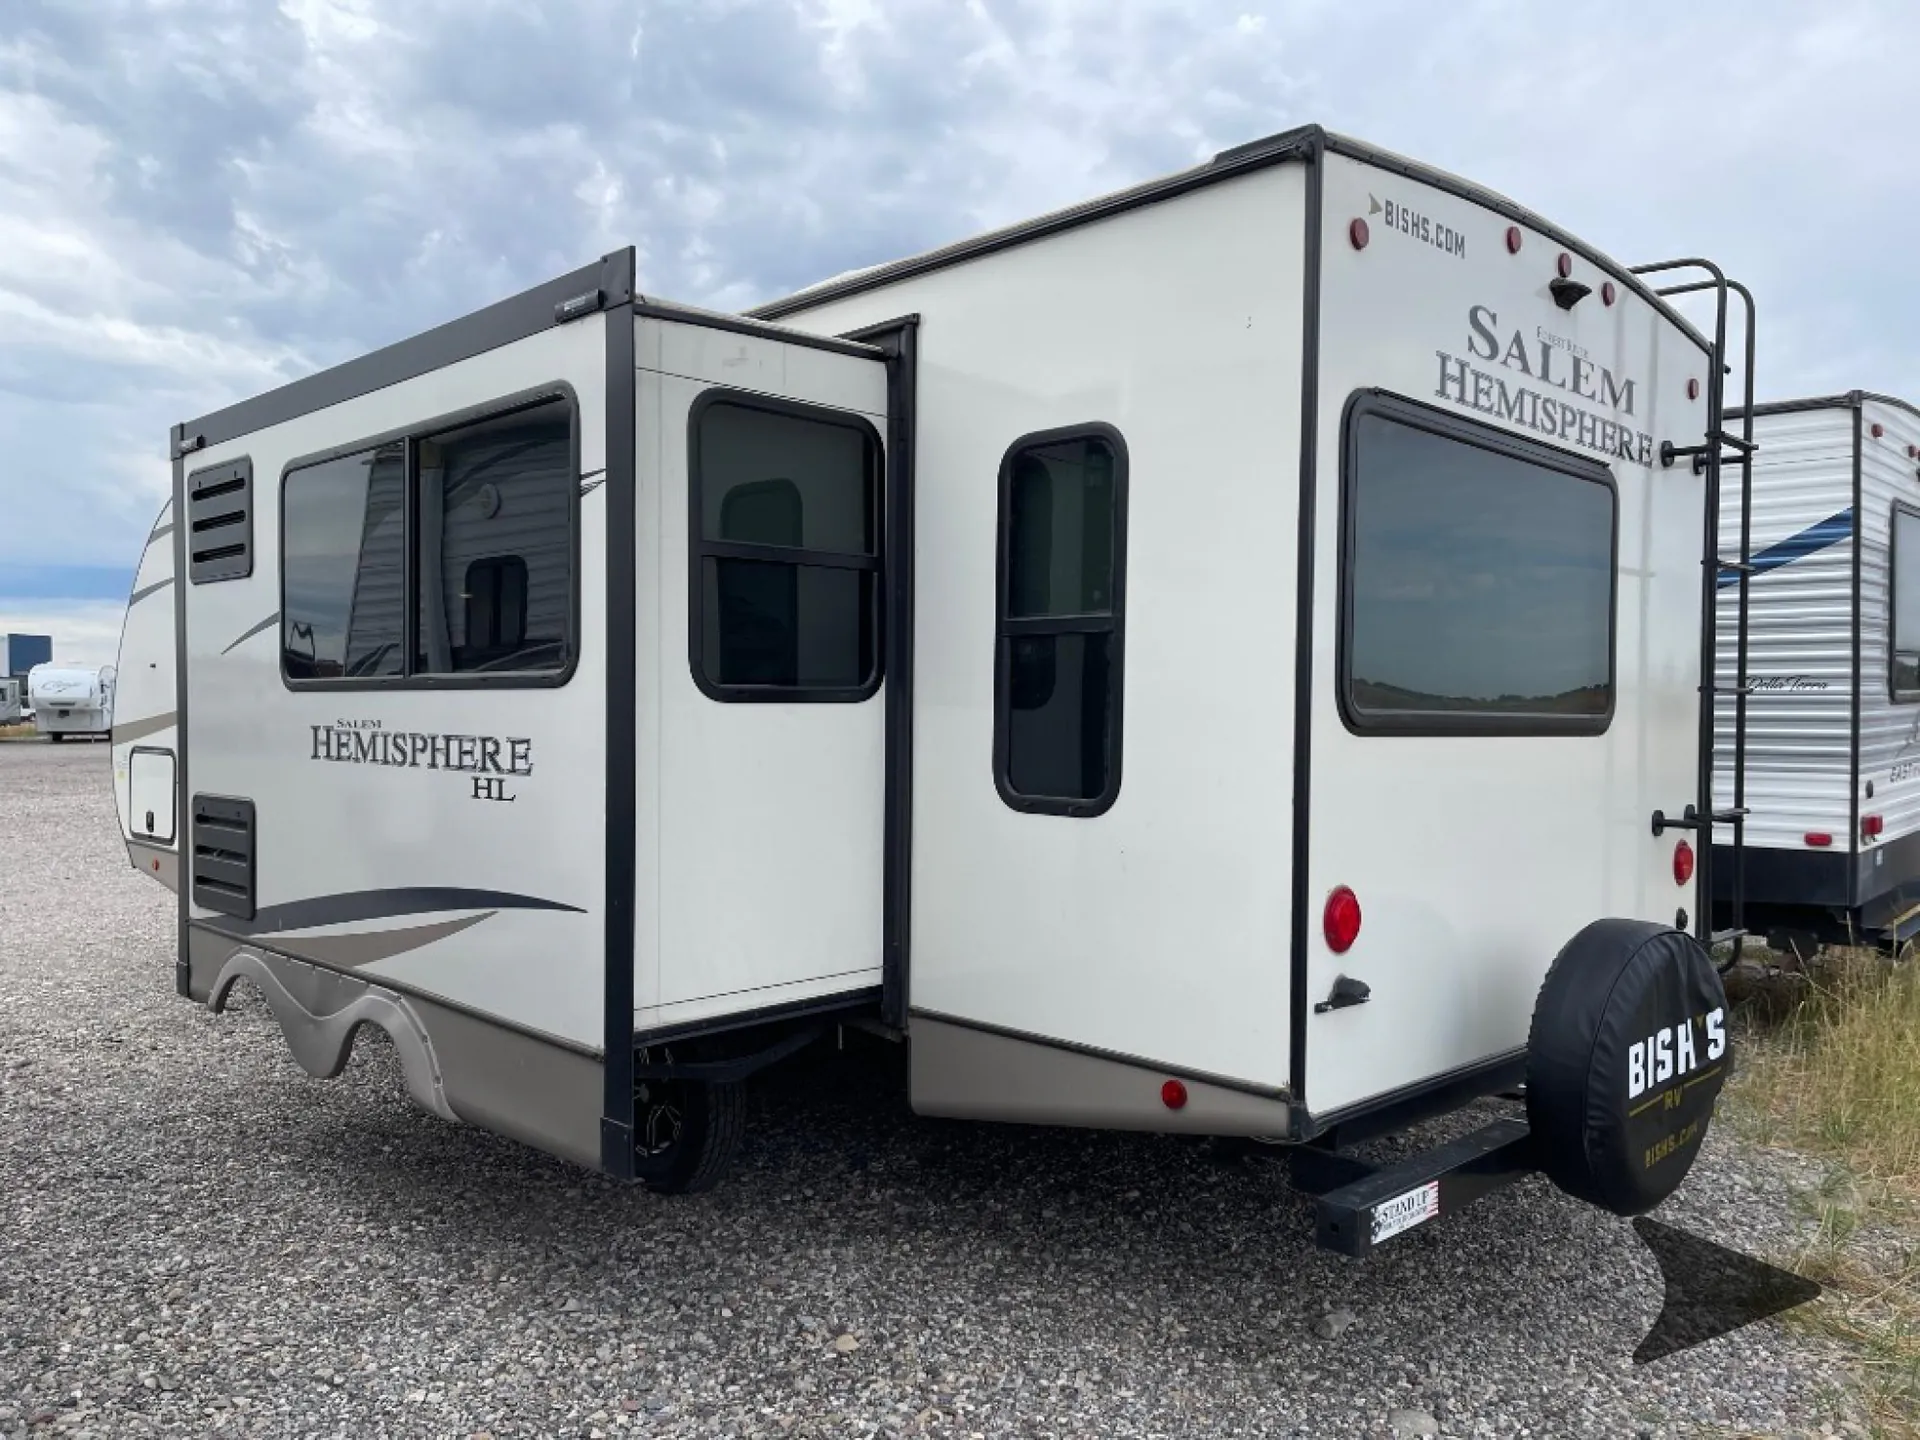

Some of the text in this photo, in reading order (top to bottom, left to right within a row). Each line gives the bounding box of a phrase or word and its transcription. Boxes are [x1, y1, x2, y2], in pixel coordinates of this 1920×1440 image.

[1385, 199, 1465, 259] BISHS.COM
[1468, 304, 1636, 416] SALEM
[1435, 350, 1653, 468] HEMISPHERE
[336, 718, 382, 729] SALEM
[310, 725, 534, 776] HEMISPHERE
[471, 776, 516, 801] HL
[1664, 1086, 1682, 1111] RV
